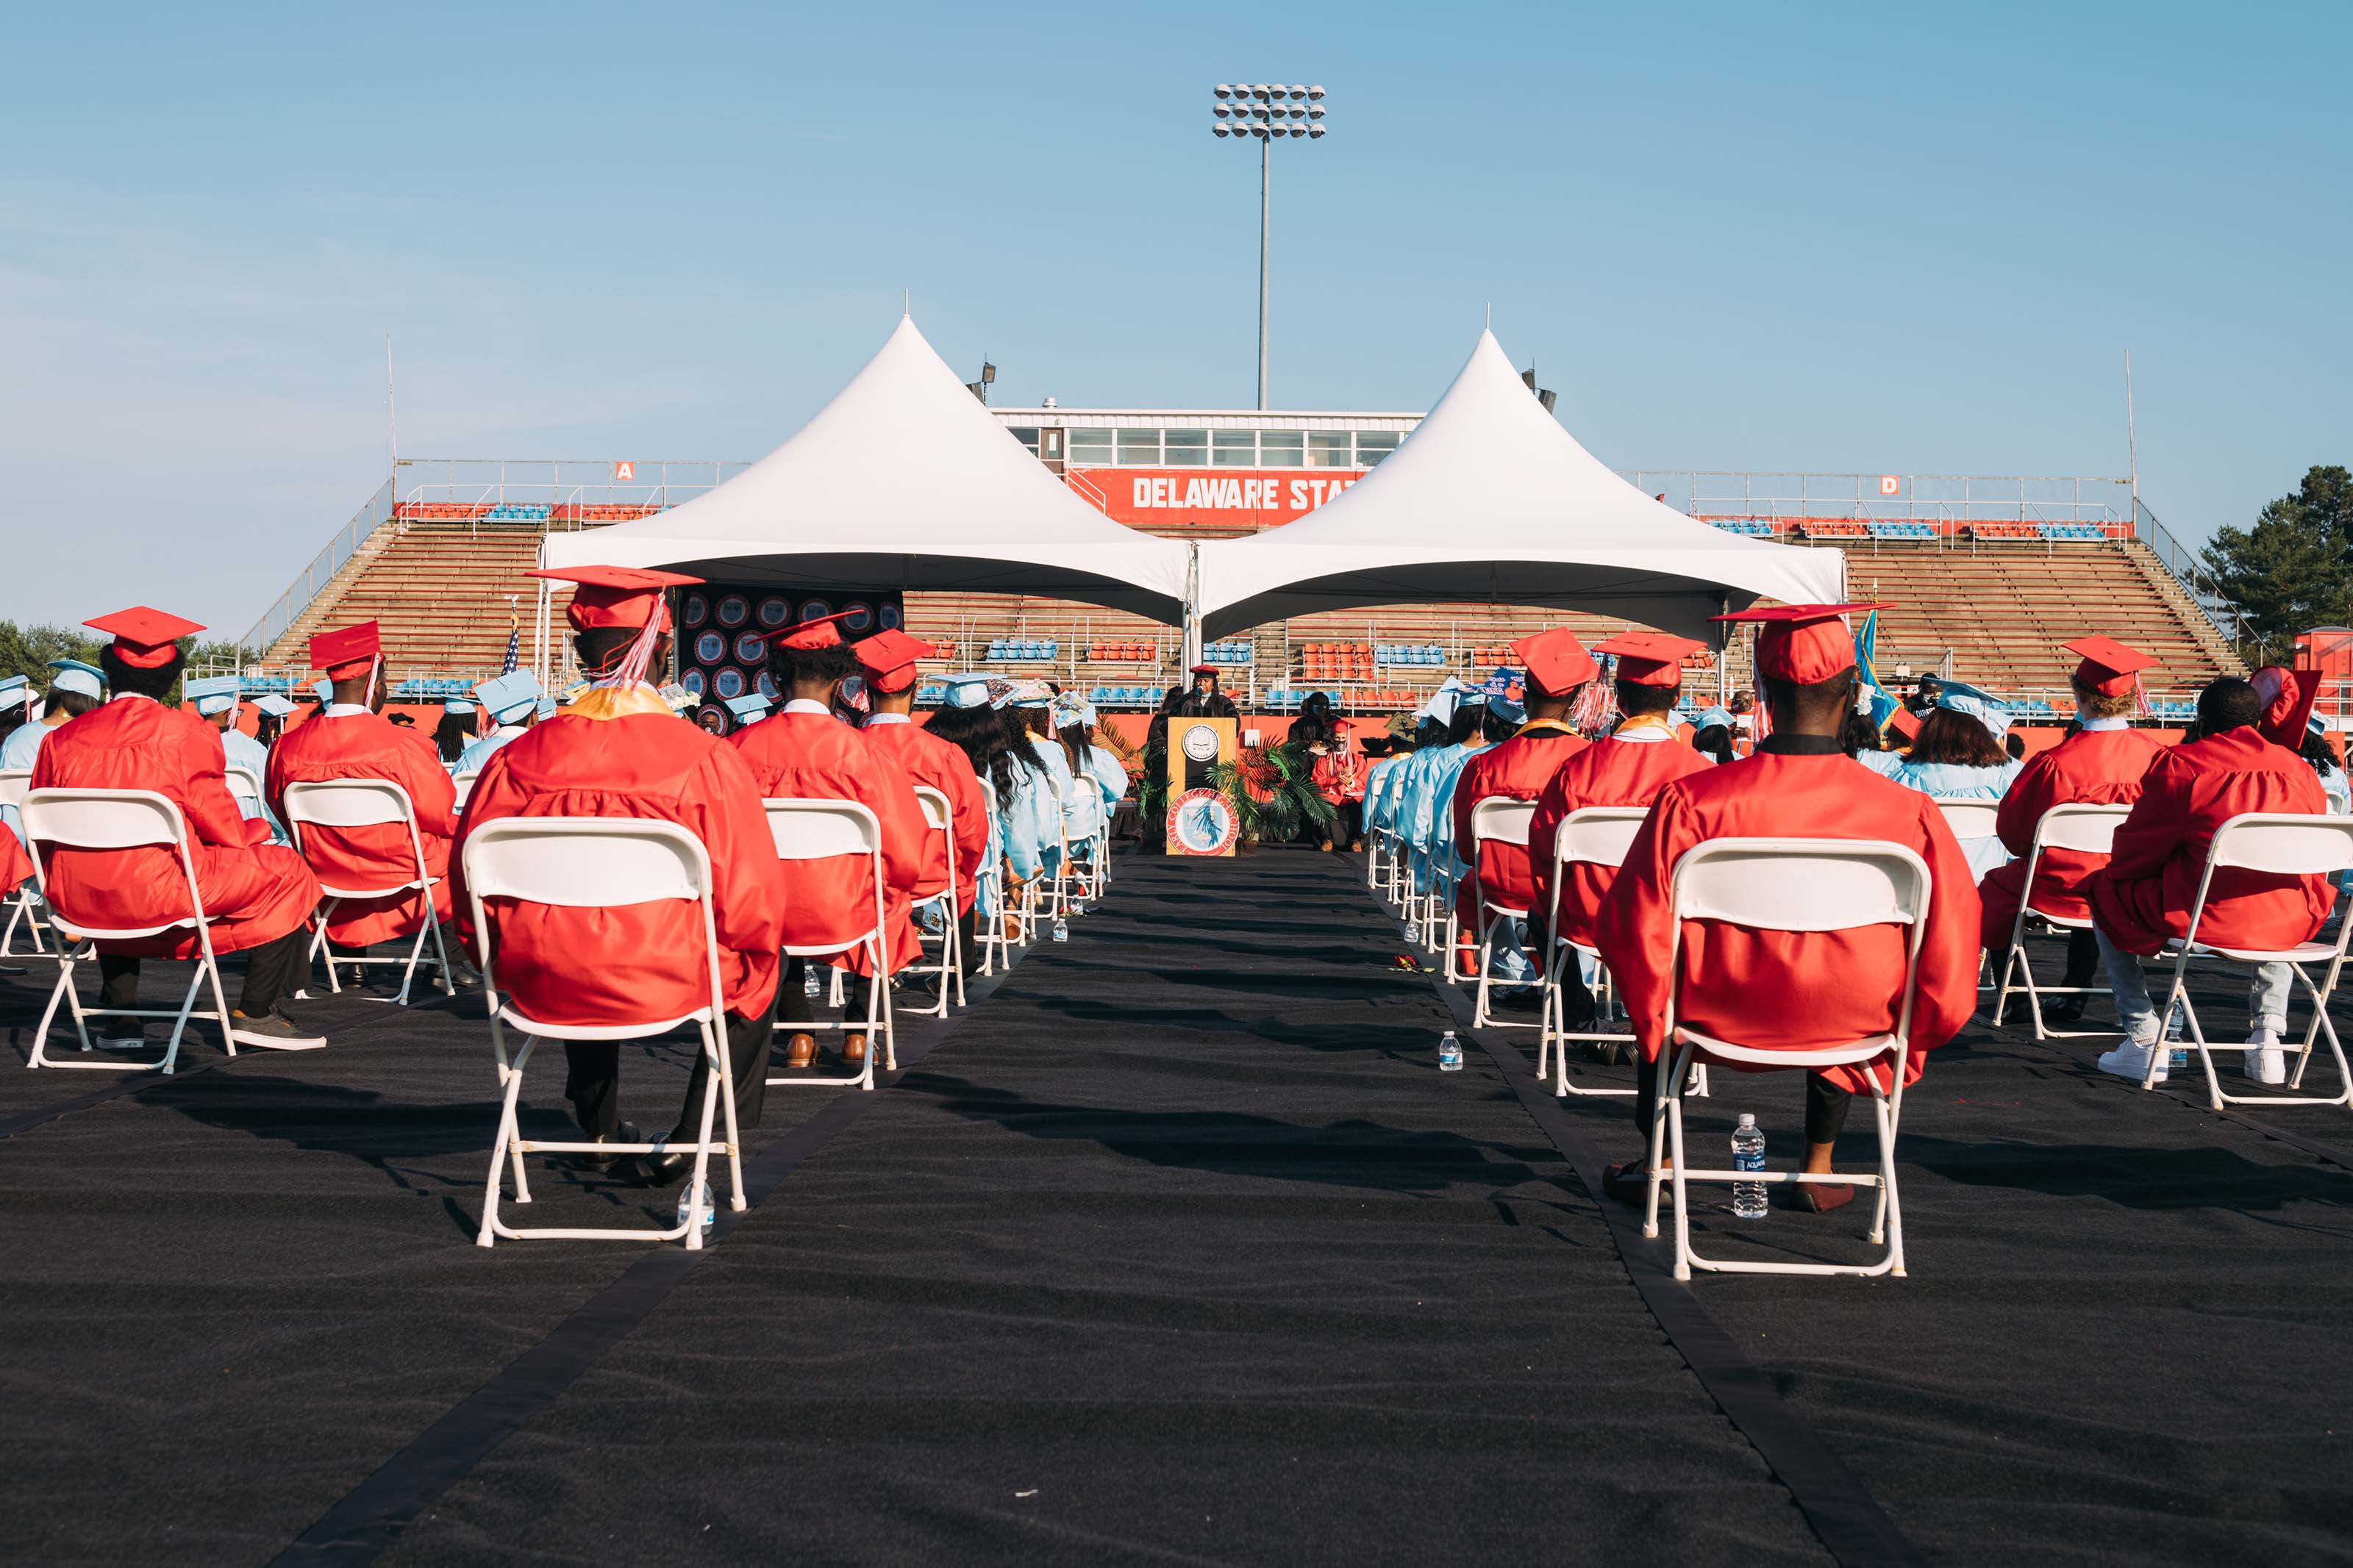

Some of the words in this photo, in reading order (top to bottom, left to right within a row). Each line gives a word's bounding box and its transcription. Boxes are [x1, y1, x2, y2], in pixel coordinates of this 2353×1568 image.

[617, 462, 633, 479] A
[1882, 477, 1897, 493] D
[1133, 478, 1279, 509] DELAWARE
[1168, 789, 1206, 821] COLLEGE
[1168, 823, 1188, 853] EARLY
[1222, 811, 1239, 851] SCHOOL
